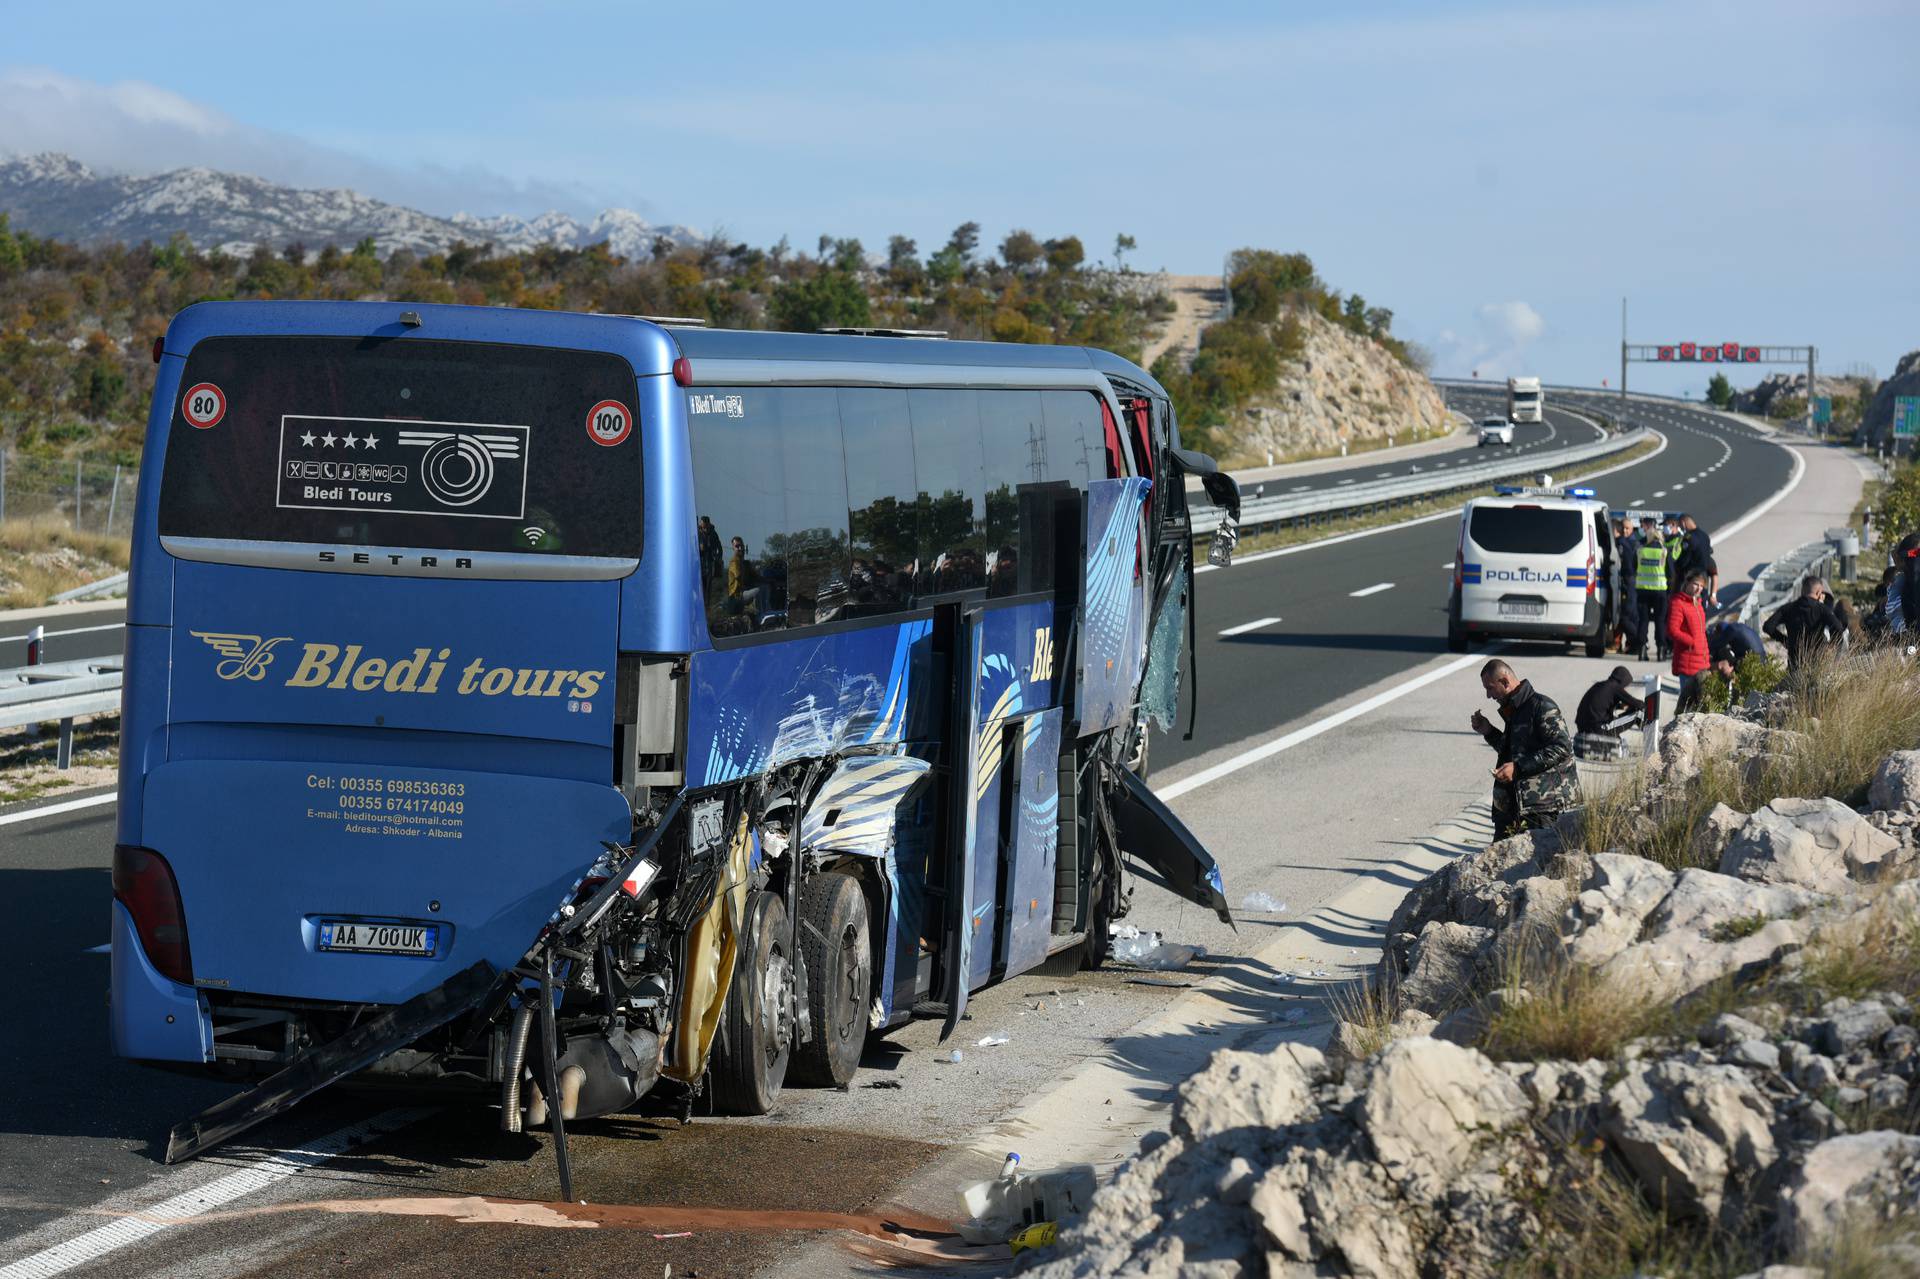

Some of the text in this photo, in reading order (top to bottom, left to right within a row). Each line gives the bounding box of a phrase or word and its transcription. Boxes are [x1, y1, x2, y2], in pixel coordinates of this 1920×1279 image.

[193, 396, 215, 415] 80
[596, 412, 623, 432] 100
[303, 485, 393, 503] Bledi Tours
[318, 550, 473, 569] SETRA
[1486, 569, 1563, 583] POLICIJA
[284, 642, 607, 699] Bledi tours
[306, 774, 466, 798] Cel: 00355 698536363
[338, 794, 465, 815] 00355 674174049
[306, 808, 464, 828] E-mail: bleditours@hotmail.com
[344, 823, 381, 835] Adresa:
[382, 825, 421, 837] Shkoder
[427, 827, 464, 840] Albania
[335, 926, 357, 945] AA
